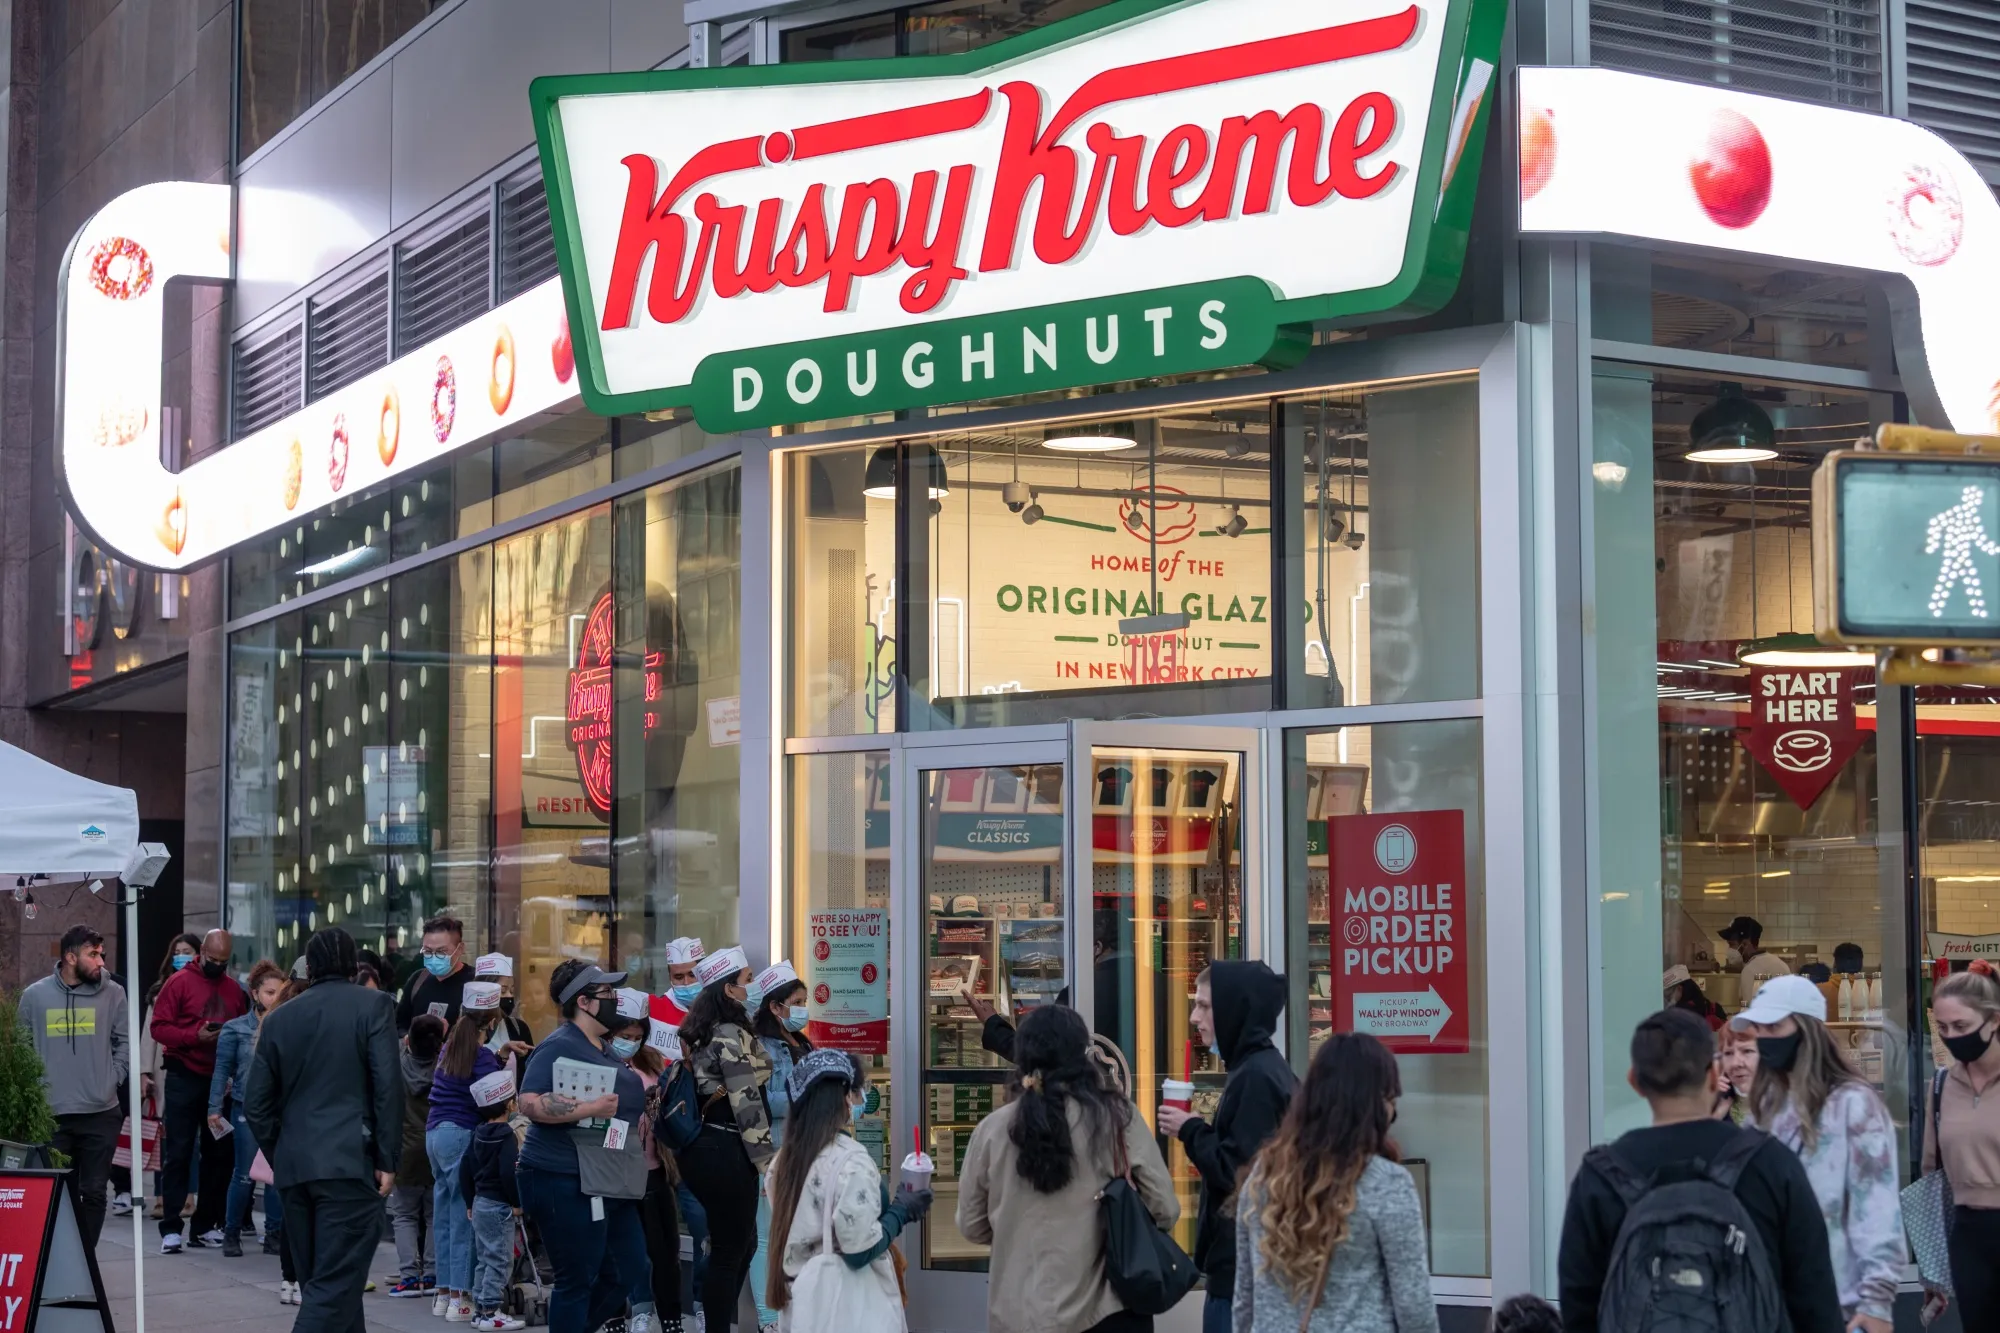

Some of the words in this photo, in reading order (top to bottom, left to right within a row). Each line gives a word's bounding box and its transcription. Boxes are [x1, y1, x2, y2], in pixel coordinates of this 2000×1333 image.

[601, 86, 991, 331] Krispy
[979, 4, 1418, 272] Kreme
[732, 299, 1228, 413] DOUGHNUTS
[1091, 554, 1151, 572] HOME
[1158, 550, 1185, 582] of
[1187, 559, 1224, 577] THE
[1056, 661, 1079, 679] IN
[1211, 667, 1259, 681] CITY
[1761, 672, 1842, 697] START
[1765, 699, 1839, 723] HERE
[571, 721, 611, 742] ORIGINA
[967, 831, 1031, 844] CLASSICS
[1343, 884, 1452, 913] MOBILE
[811, 914, 837, 923] WE'RE
[838, 914, 850, 923] SO
[852, 913, 881, 923] HAPPY
[1343, 913, 1453, 945] ORDER
[811, 925, 827, 937] TO
[829, 925, 849, 937] SEE
[852, 924, 880, 937] YOU!
[1344, 945, 1454, 976] PICKUP
[1359, 1009, 1398, 1018] WALK-UP
[1399, 1008, 1440, 1018] WINDOW
[1380, 998, 1408, 1006] PICKUP
[1410, 998, 1419, 1006] AT
[1370, 1020, 1382, 1028] ON
[1385, 1019, 1429, 1028] BROADWAY
